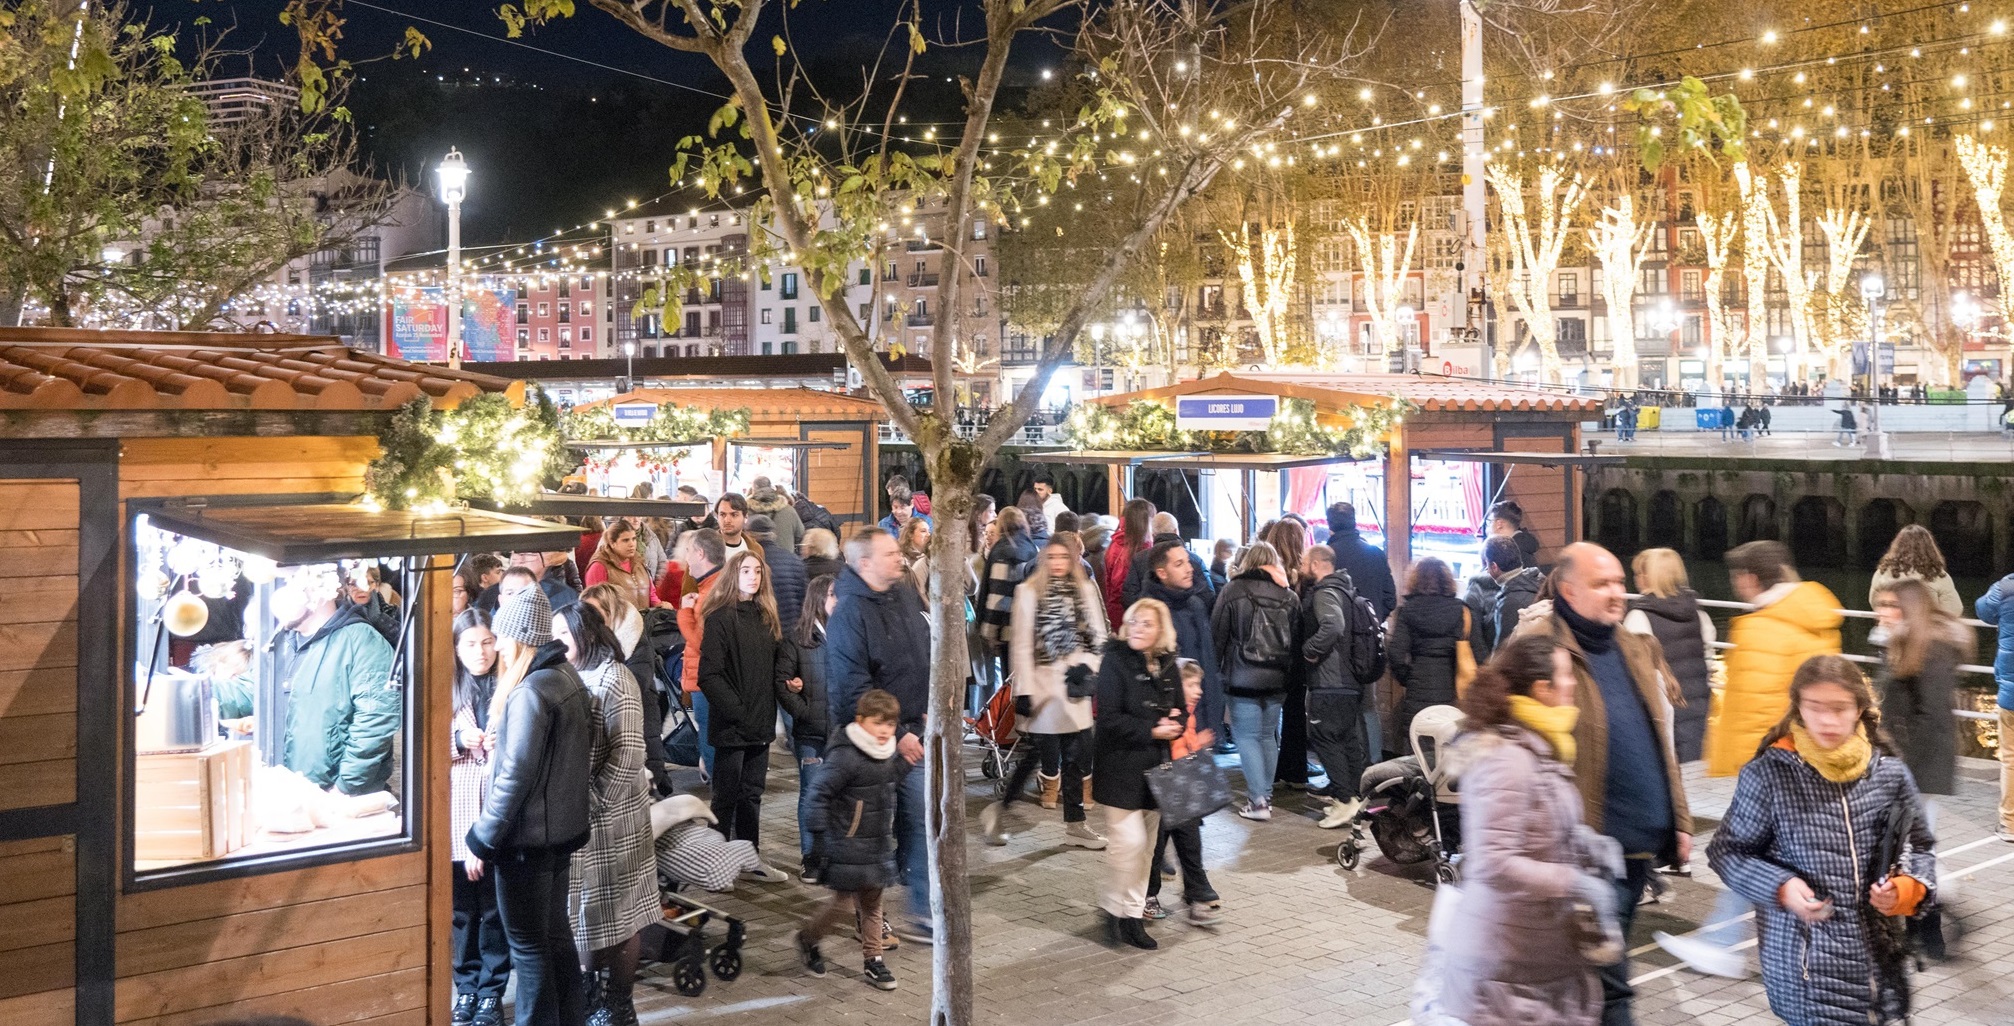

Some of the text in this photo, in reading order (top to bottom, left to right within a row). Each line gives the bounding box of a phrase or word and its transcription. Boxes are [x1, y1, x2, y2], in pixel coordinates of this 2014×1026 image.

[396, 316, 414, 324] FAIR
[396, 324, 443, 332] SATURDAY
[1208, 403, 1230, 414] LICORES
